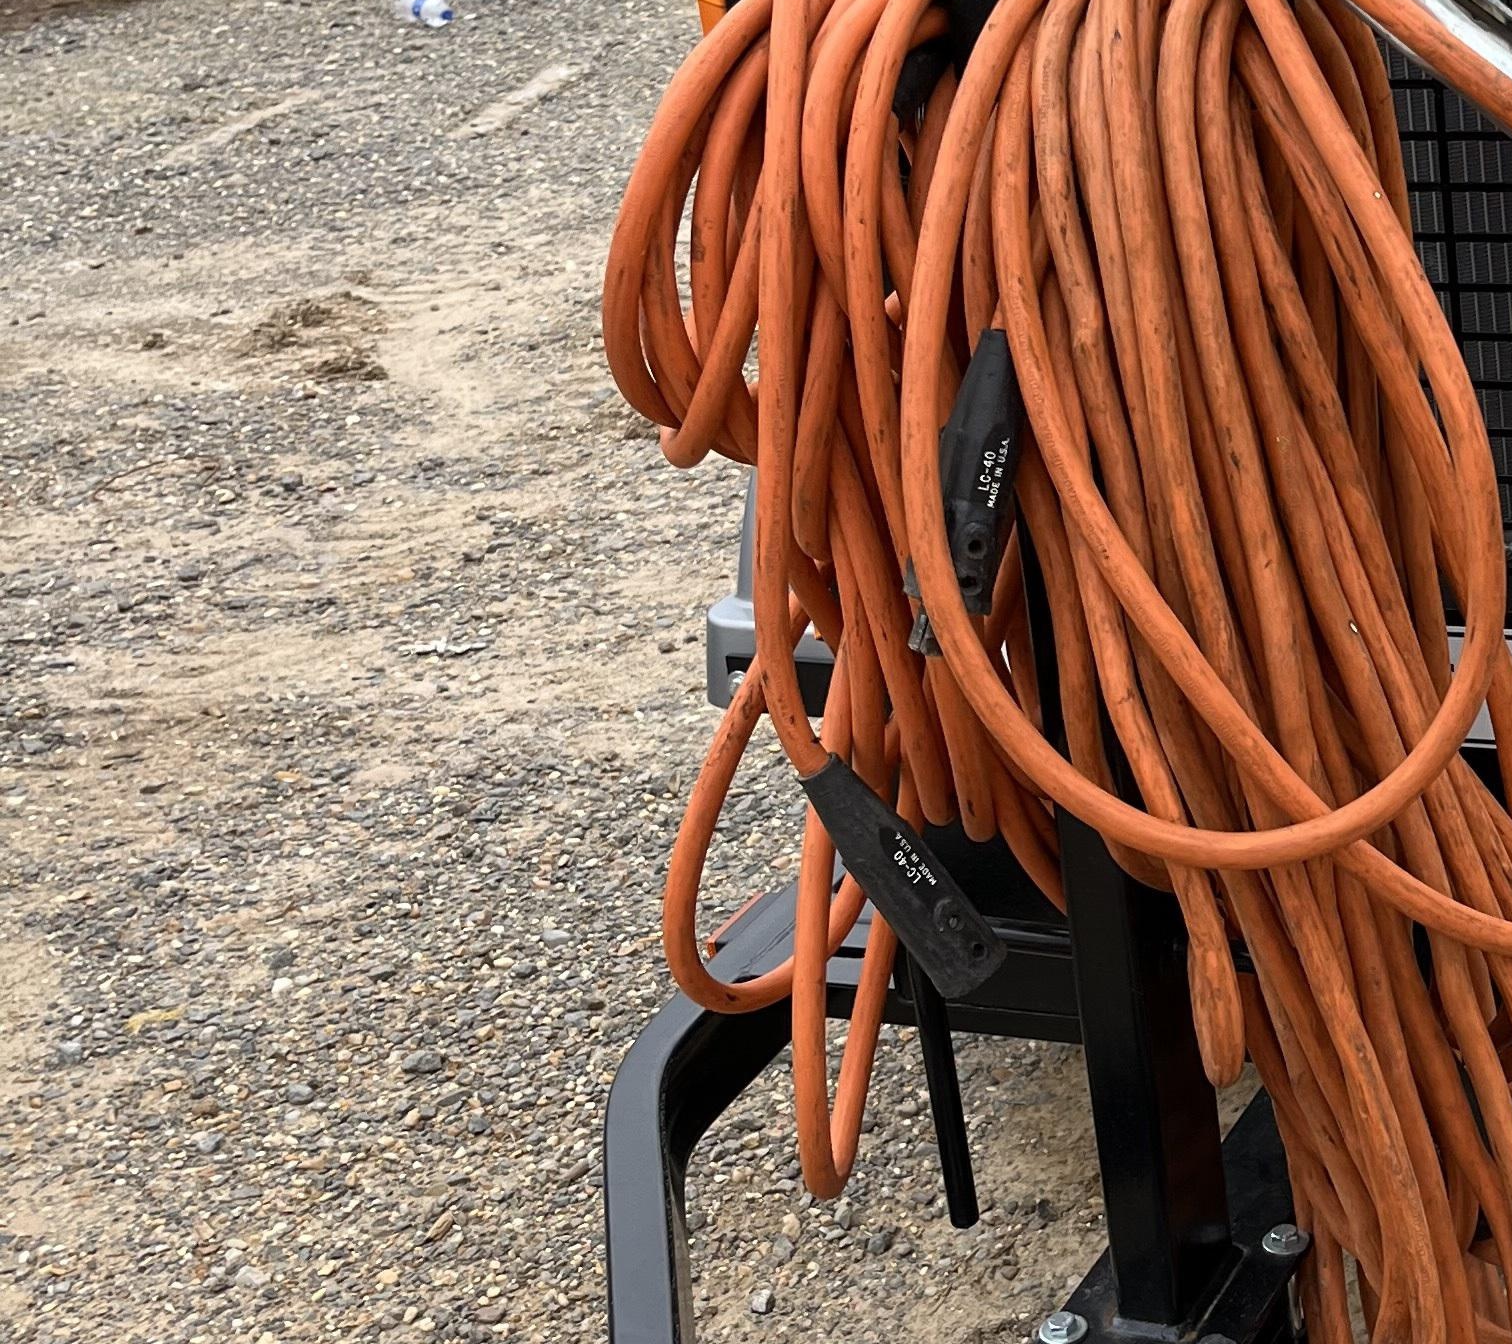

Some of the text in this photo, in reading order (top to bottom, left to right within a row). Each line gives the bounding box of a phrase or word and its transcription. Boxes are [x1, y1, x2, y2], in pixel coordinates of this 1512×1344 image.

[977, 451, 996, 491] LC-40
[987, 482, 1000, 508] MADE
[994, 467, 1003, 477] IN
[894, 850, 921, 884] LC-40
[910, 853, 919, 863] IN
[918, 862, 937, 886] MADE
